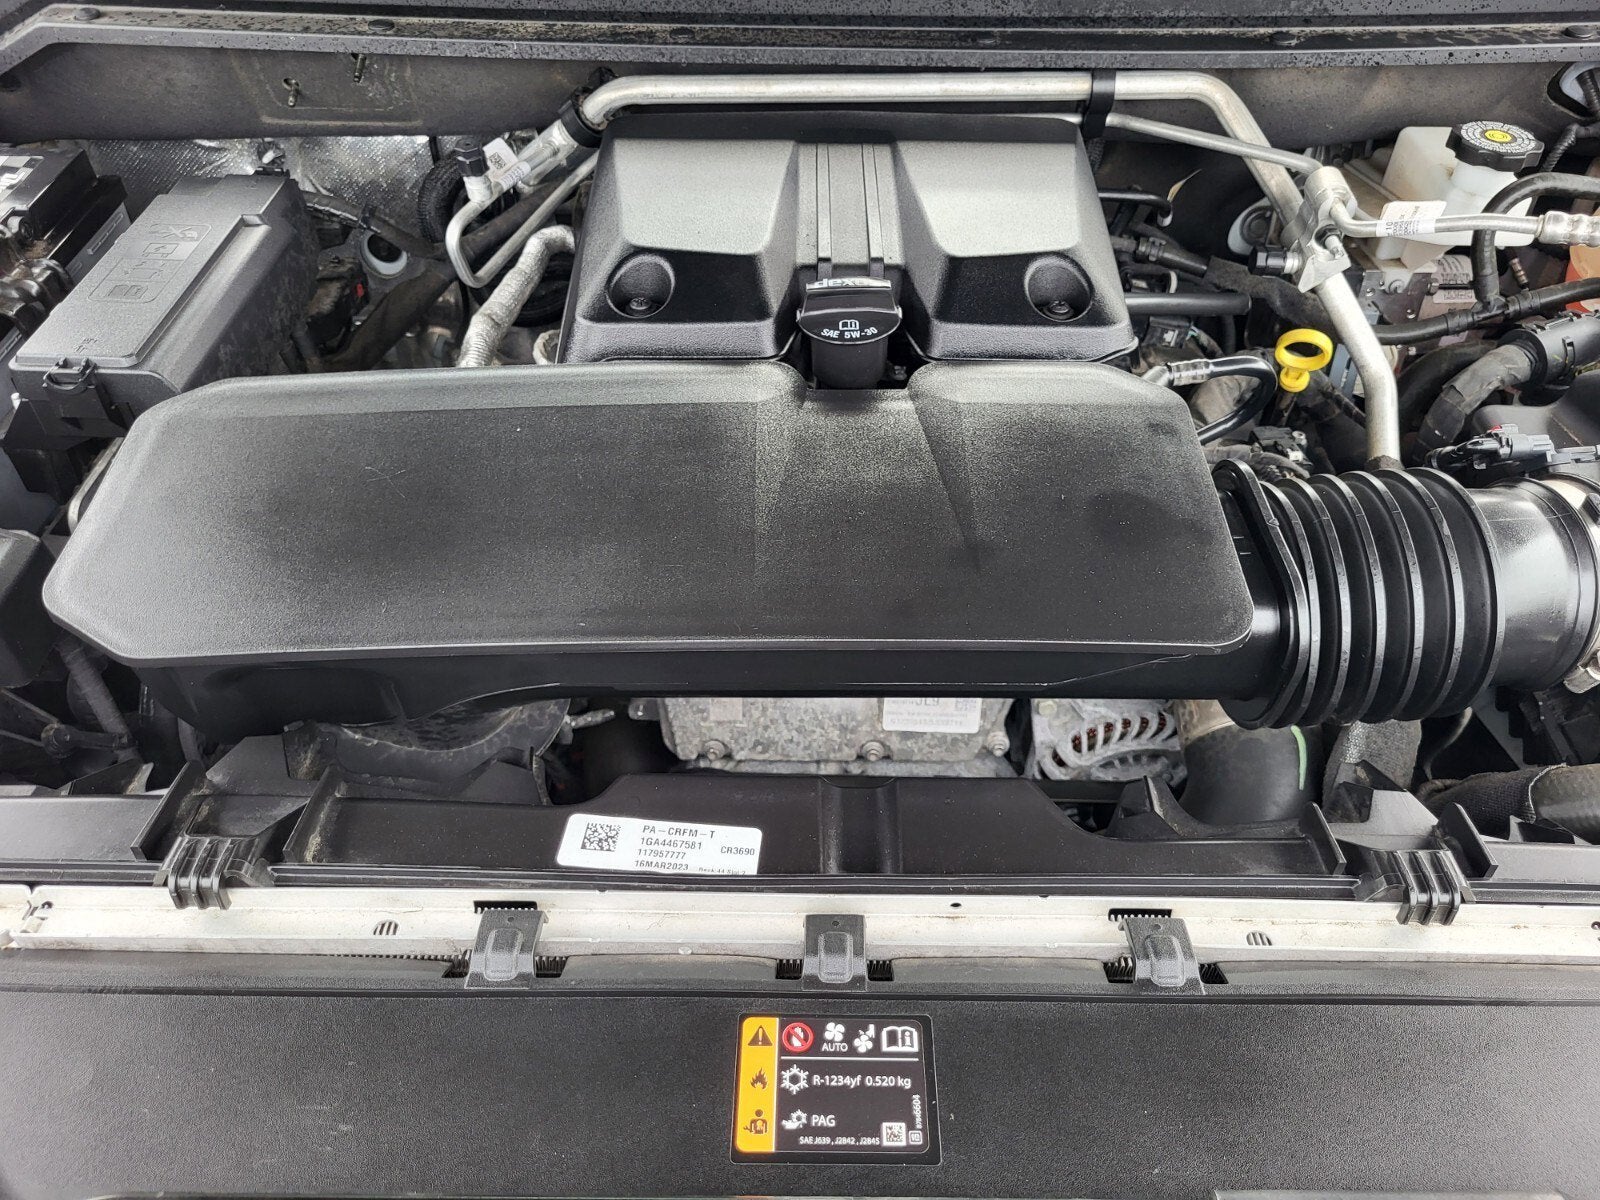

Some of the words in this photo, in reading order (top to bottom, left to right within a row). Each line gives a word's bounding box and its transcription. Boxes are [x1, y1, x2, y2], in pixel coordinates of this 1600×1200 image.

[821, 328, 840, 338] SAE
[844, 327, 878, 338] 5W-30
[640, 837, 702, 850] 1GA4467581
[637, 848, 686, 859] 117957777
[720, 845, 755, 856] CR3690
[634, 859, 689, 871] 16MAR2023
[822, 1042, 848, 1052] AUTO
[813, 1075, 861, 1089] R-1234yf
[866, 1075, 896, 1087] 0.520
[898, 1075, 911, 1089] kg
[811, 1114, 836, 1127] PAG
[799, 1136, 814, 1145] SAE
